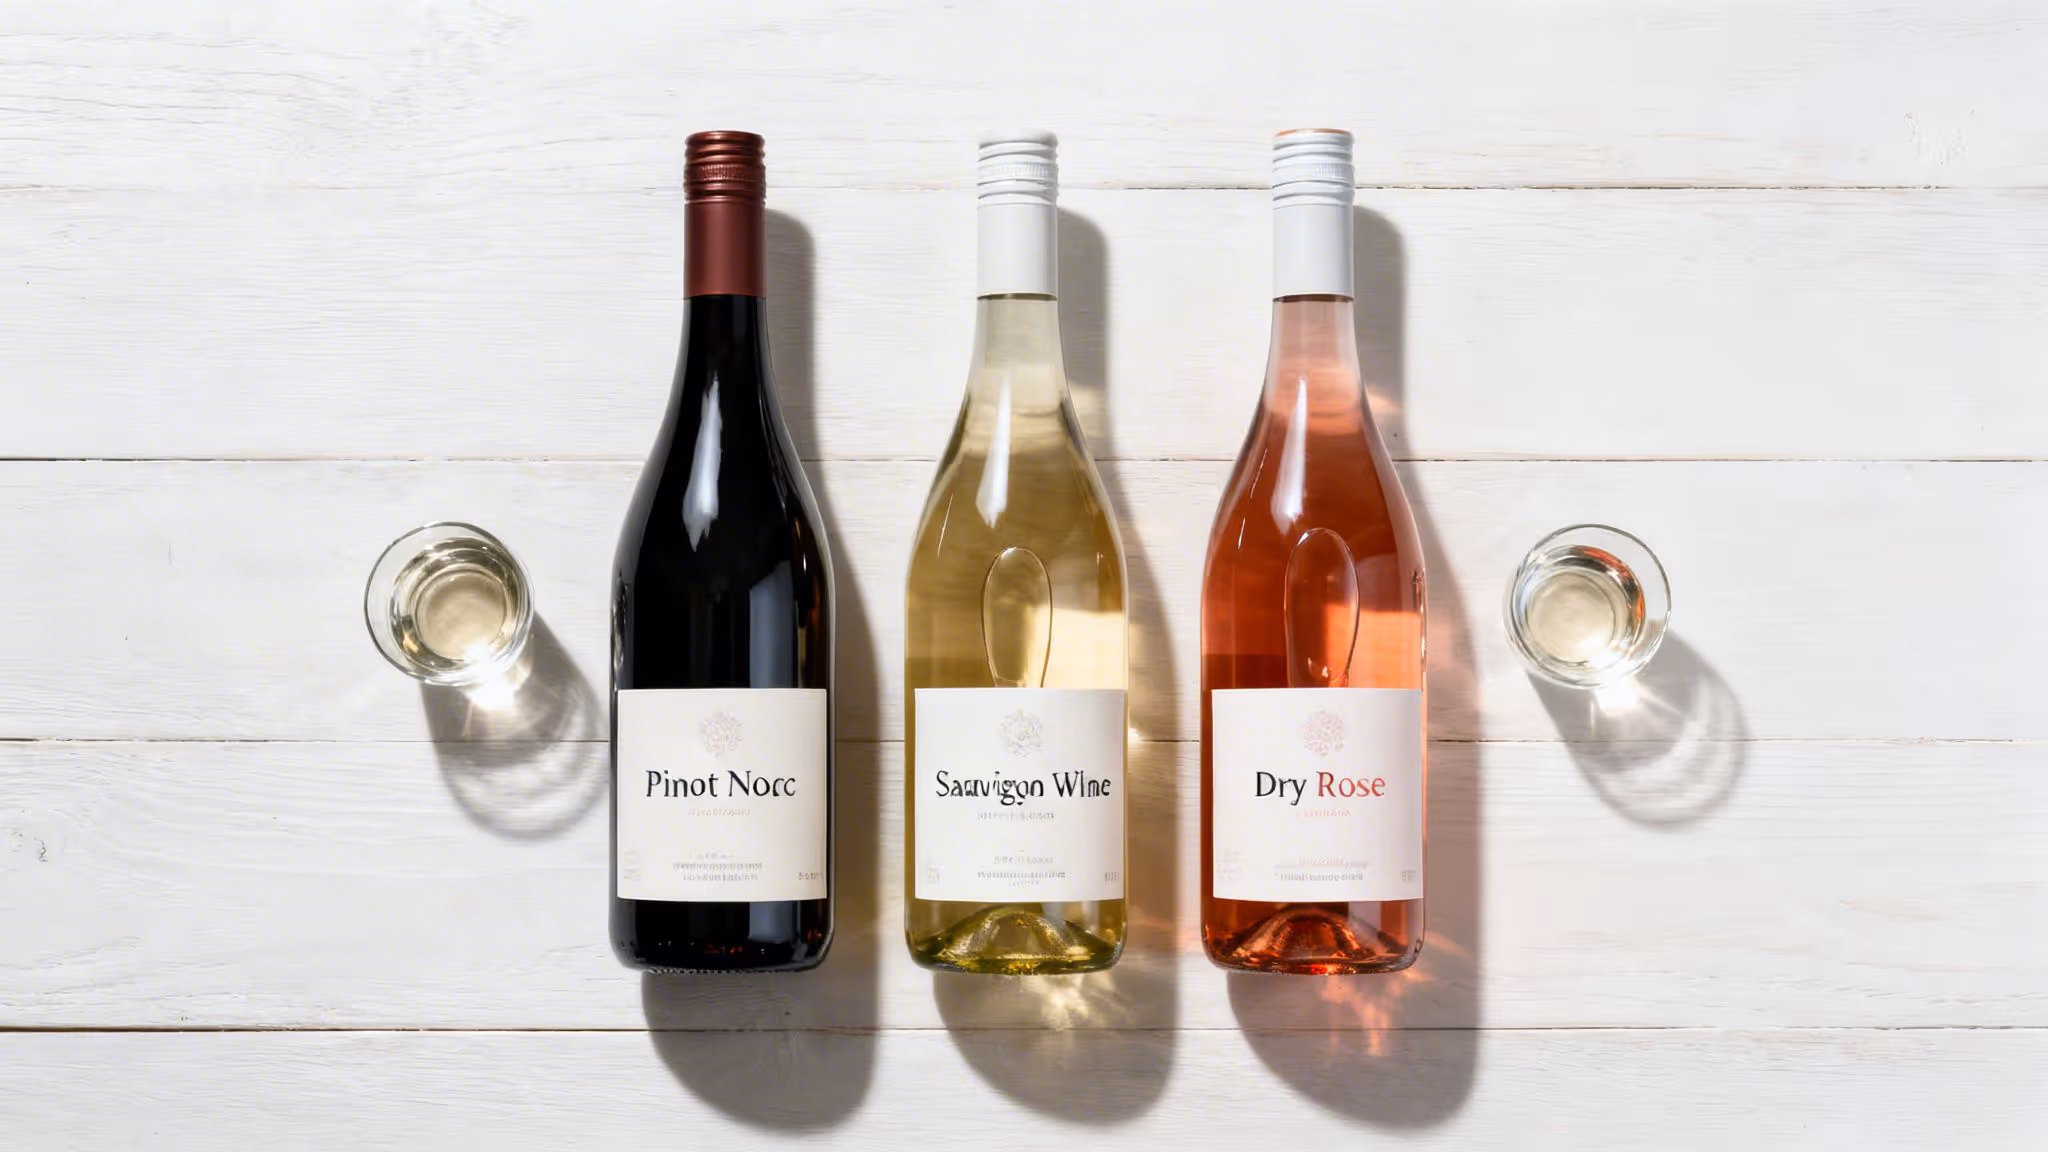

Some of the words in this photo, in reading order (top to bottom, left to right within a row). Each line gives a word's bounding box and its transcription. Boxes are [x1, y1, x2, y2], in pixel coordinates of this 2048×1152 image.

[646, 770, 719, 798] Pinot
[1255, 771, 1307, 806] Dry
[1316, 771, 1386, 798] Rose
